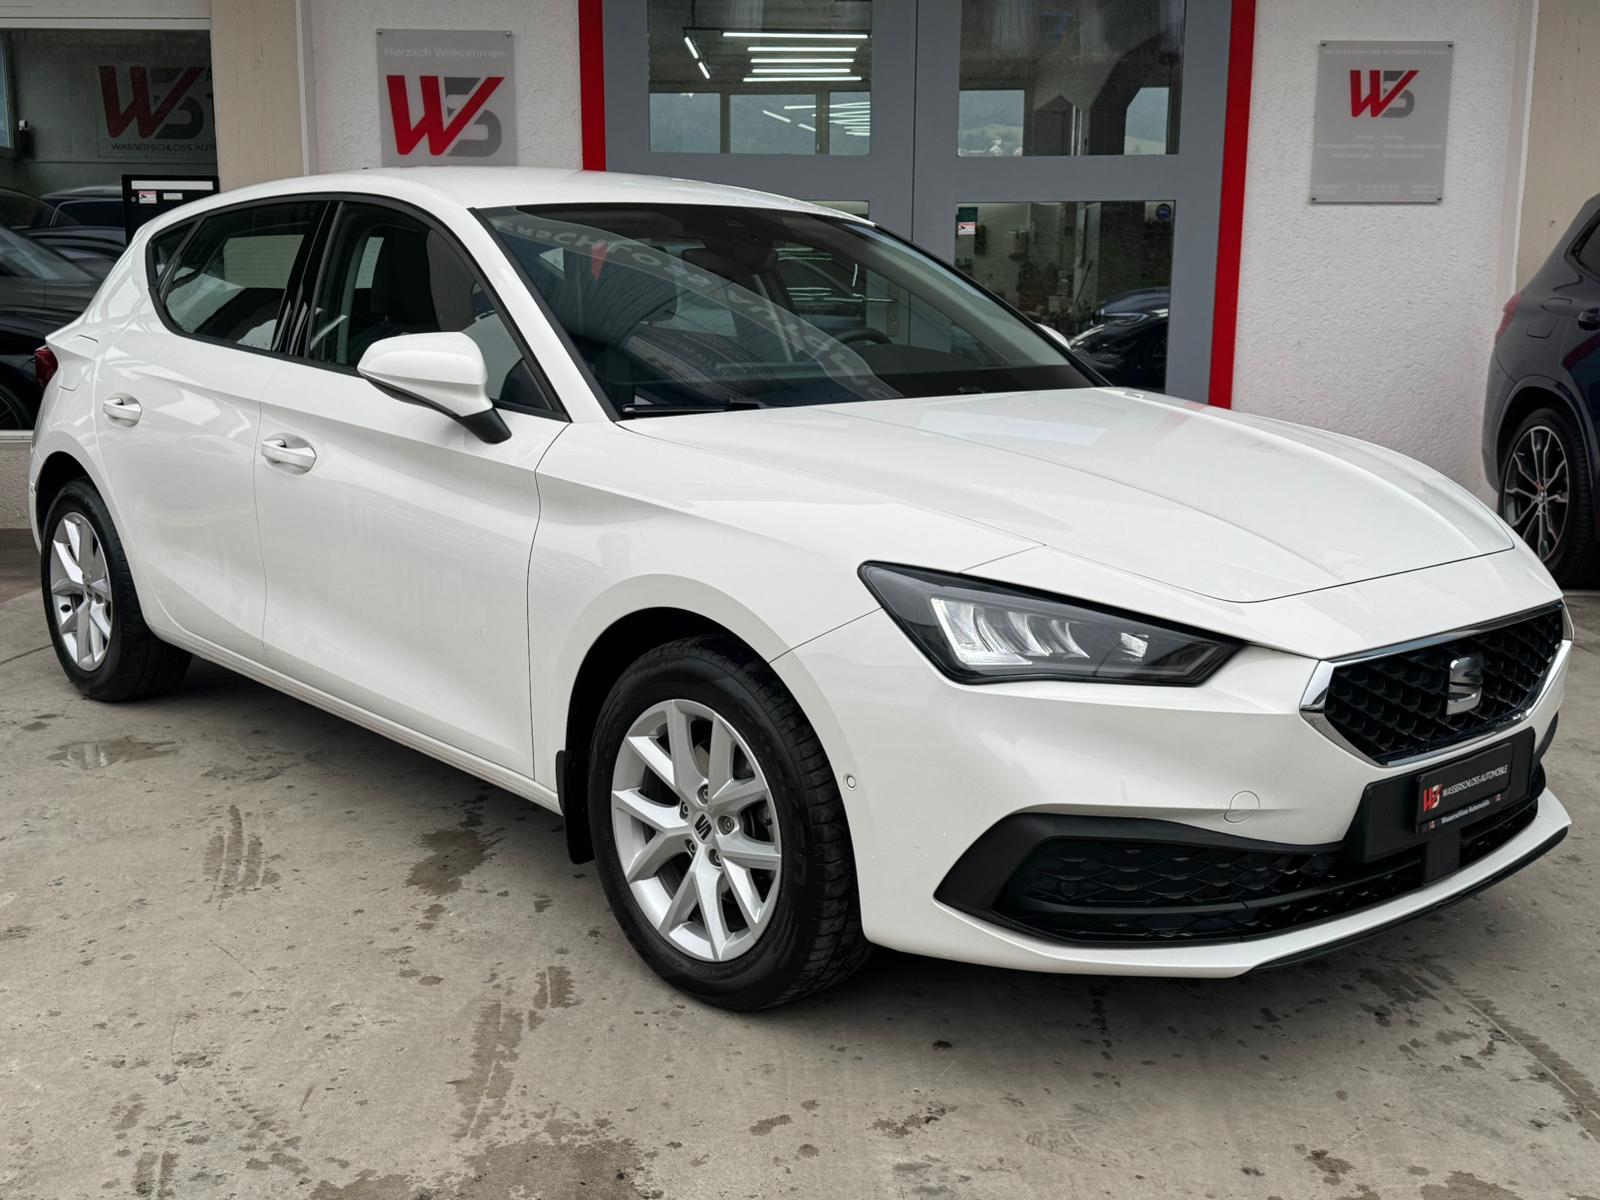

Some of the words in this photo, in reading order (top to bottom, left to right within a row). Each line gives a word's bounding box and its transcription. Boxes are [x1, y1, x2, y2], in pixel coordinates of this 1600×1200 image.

[384, 47, 432, 58] Herzlich
[434, 47, 506, 58] Willkommen
[111, 143, 194, 152] WASSERSCHLOSS
